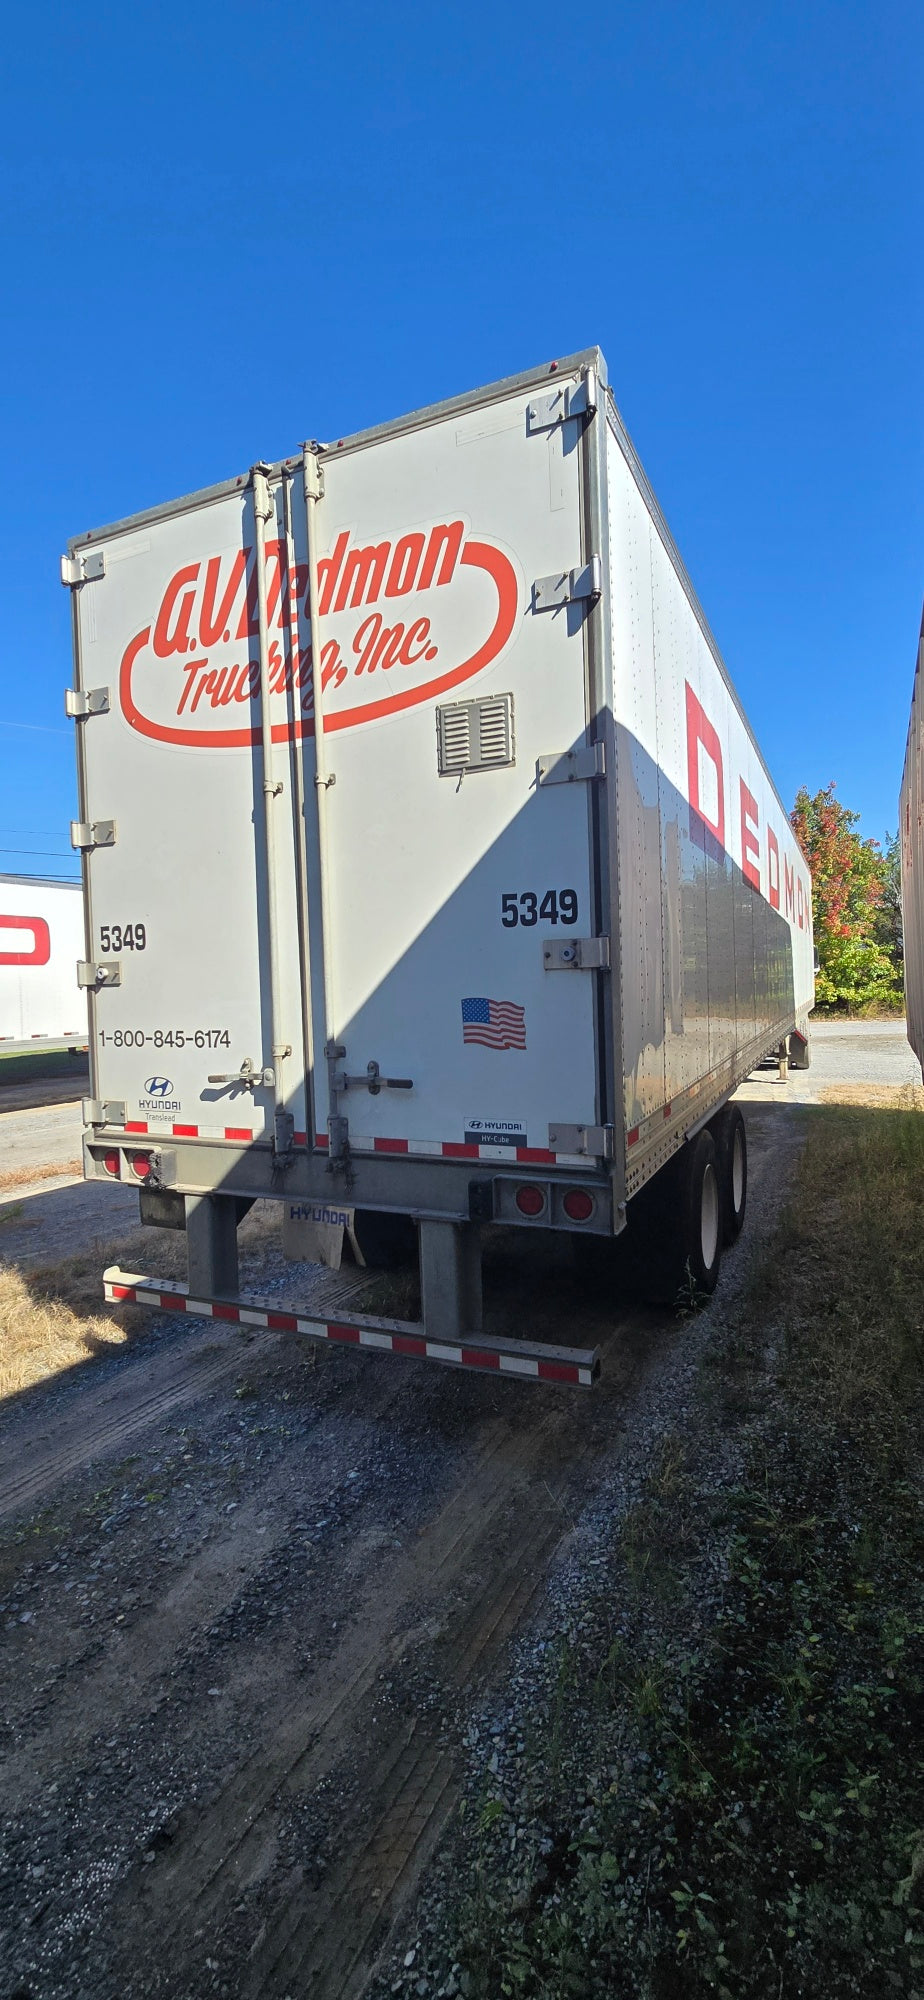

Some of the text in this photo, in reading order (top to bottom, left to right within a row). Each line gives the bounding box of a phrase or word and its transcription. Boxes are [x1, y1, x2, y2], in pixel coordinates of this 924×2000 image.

[235, 520, 465, 640] Dedmon
[353, 613, 438, 675] Inc.
[685, 678, 811, 935] DEDMON
[502, 889, 578, 927] 5349
[100, 923, 147, 952] 5349
[99, 1030, 231, 1048] 1-800-845-6174
[139, 1100, 181, 1110] HYUNDAI
[145, 1112, 175, 1122] Translead
[485, 1122, 522, 1130] HYUNDAI
[481, 1135, 510, 1143] HY-Cube
[290, 1206, 350, 1227] HYUNDAI
